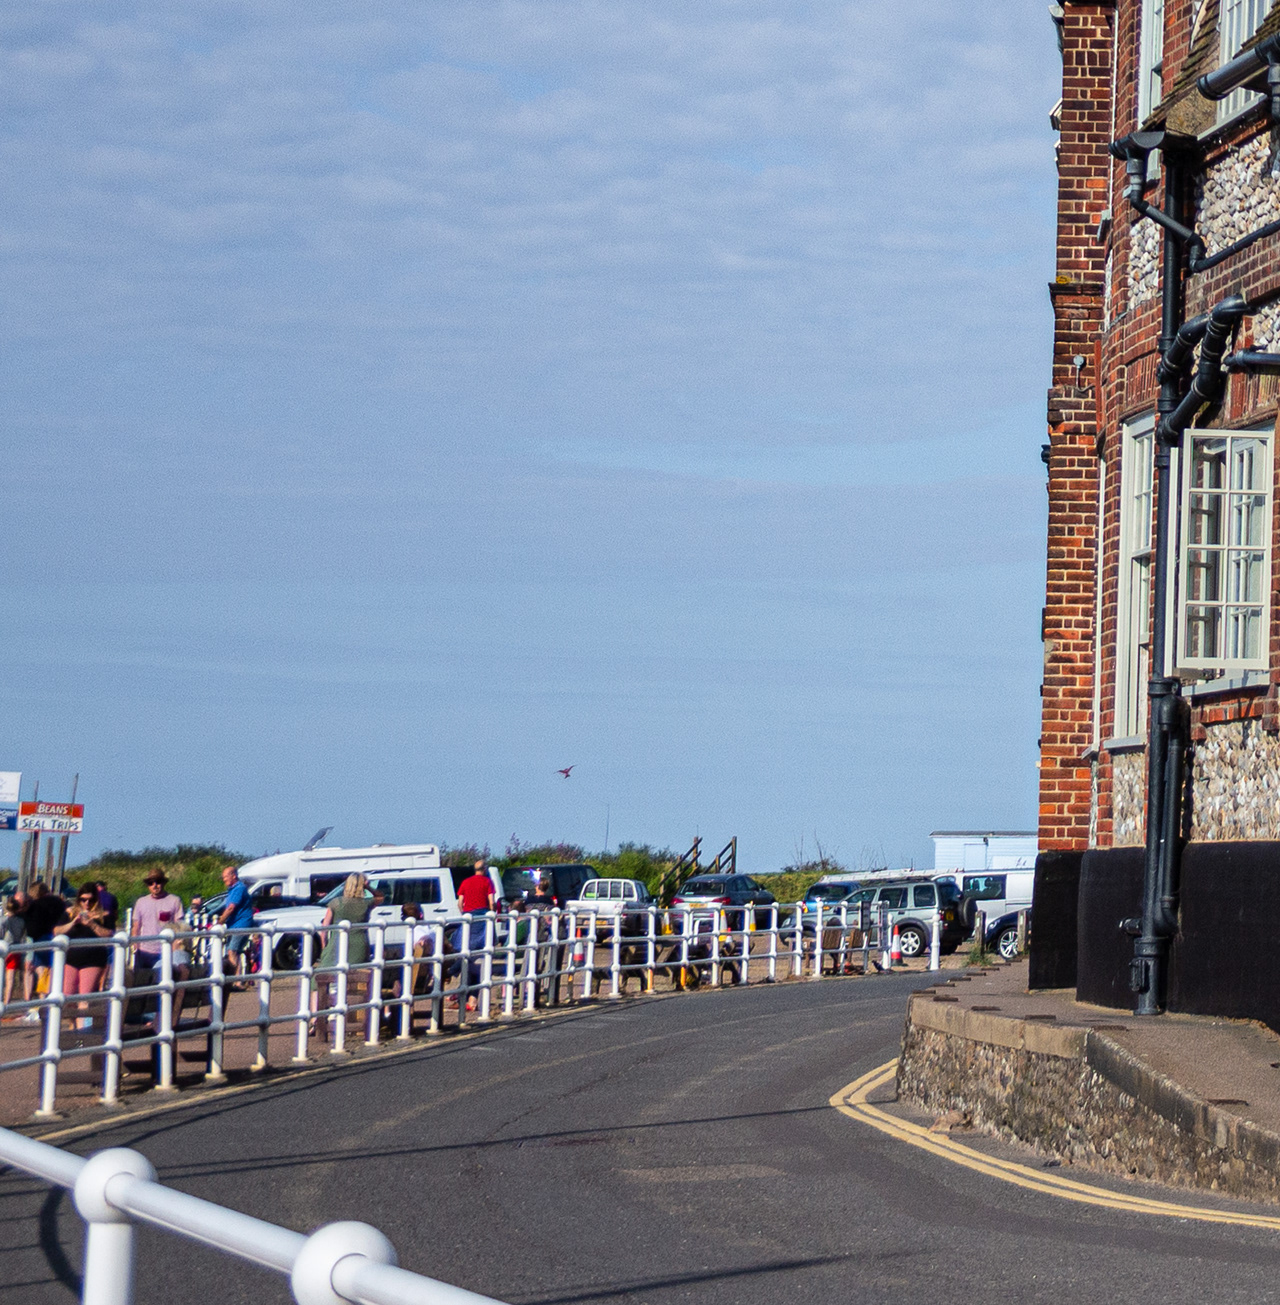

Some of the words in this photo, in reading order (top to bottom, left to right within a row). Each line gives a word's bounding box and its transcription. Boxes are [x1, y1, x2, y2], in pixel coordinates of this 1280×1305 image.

[37, 804, 69, 814] BEANS
[22, 818, 47, 831] SEAL
[51, 819, 80, 831] TRIPS
